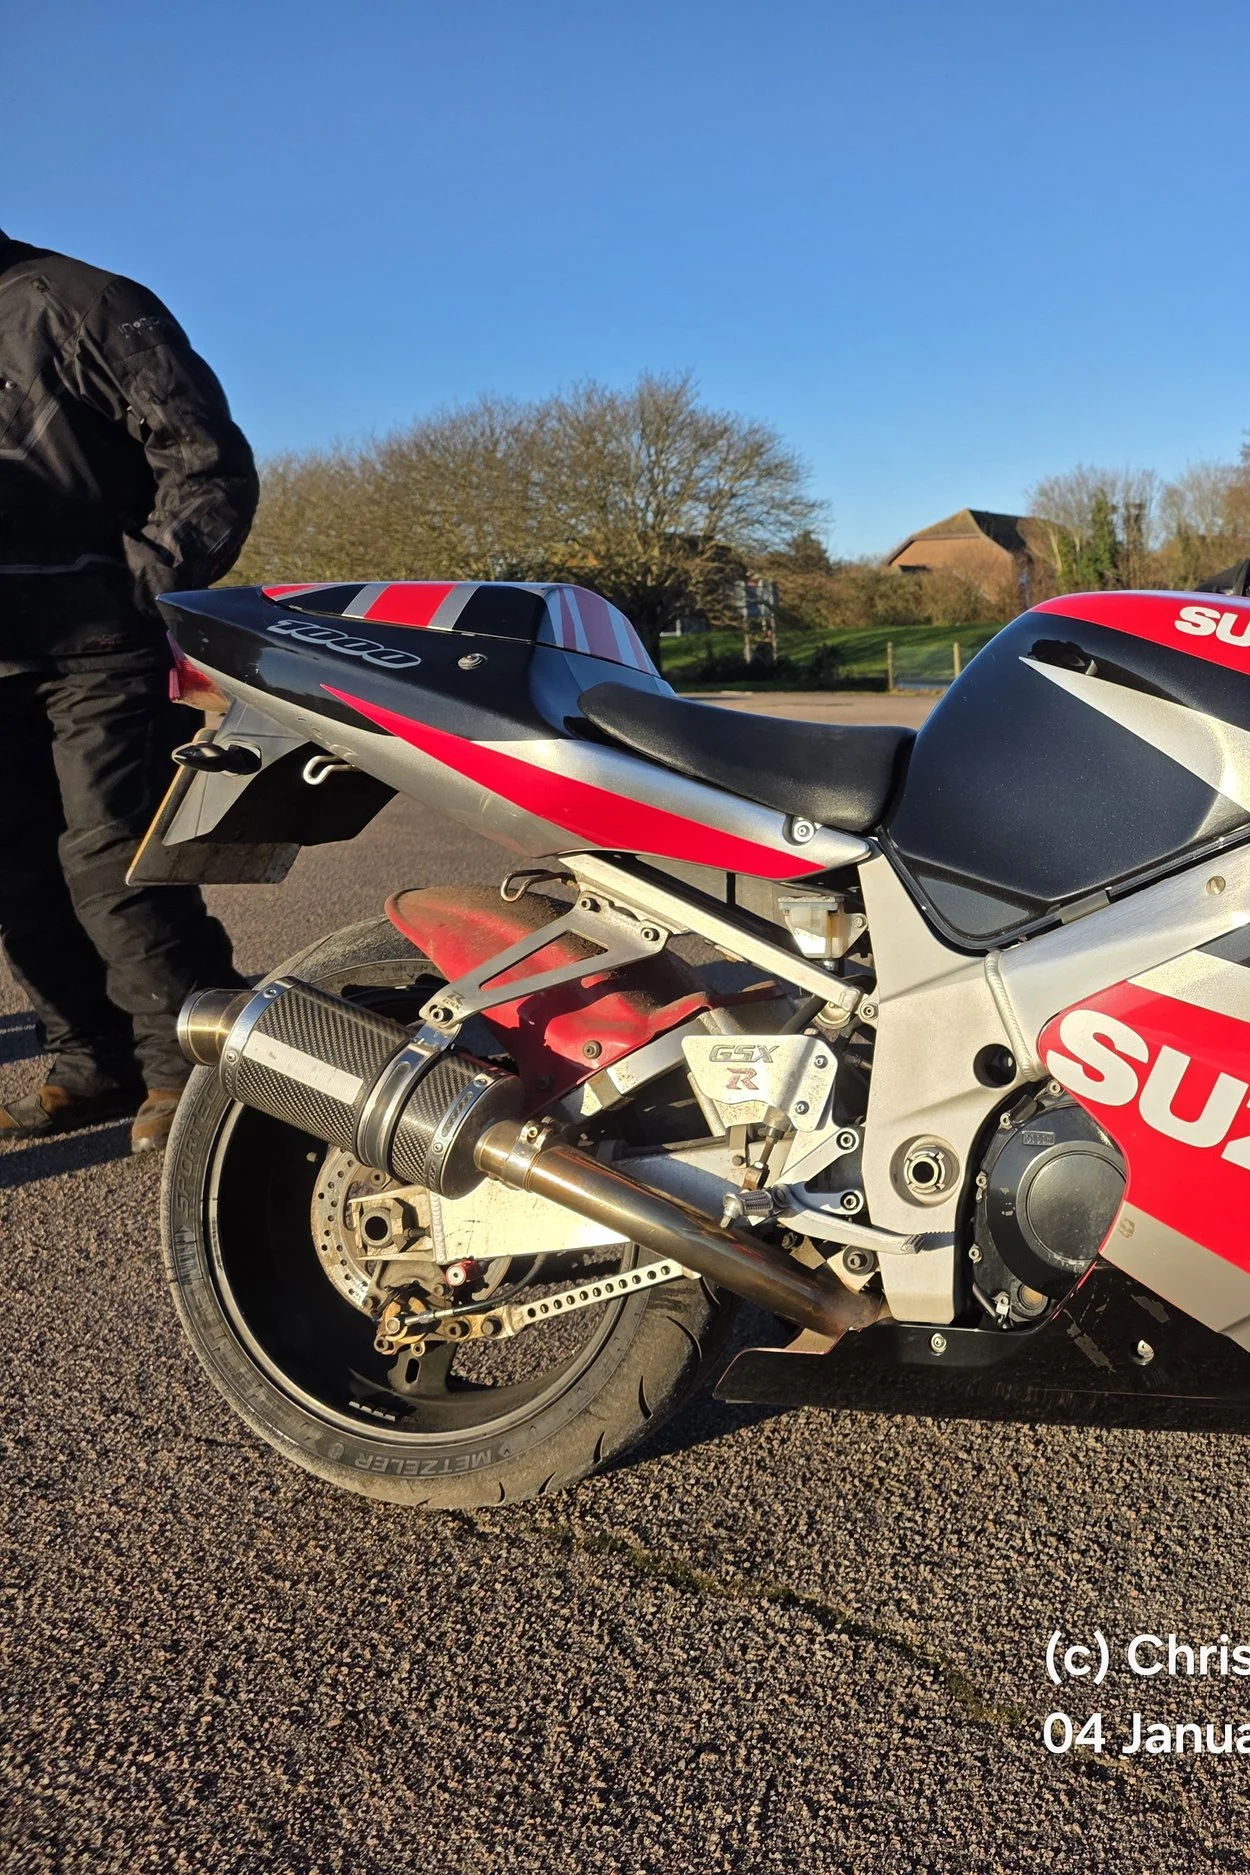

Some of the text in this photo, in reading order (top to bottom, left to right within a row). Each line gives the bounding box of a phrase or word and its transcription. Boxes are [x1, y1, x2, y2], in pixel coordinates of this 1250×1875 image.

[266, 619, 421, 669] 1000
[708, 1044, 780, 1064] GSX
[725, 1067, 760, 1091] R
[354, 1450, 492, 1475] METZELER
